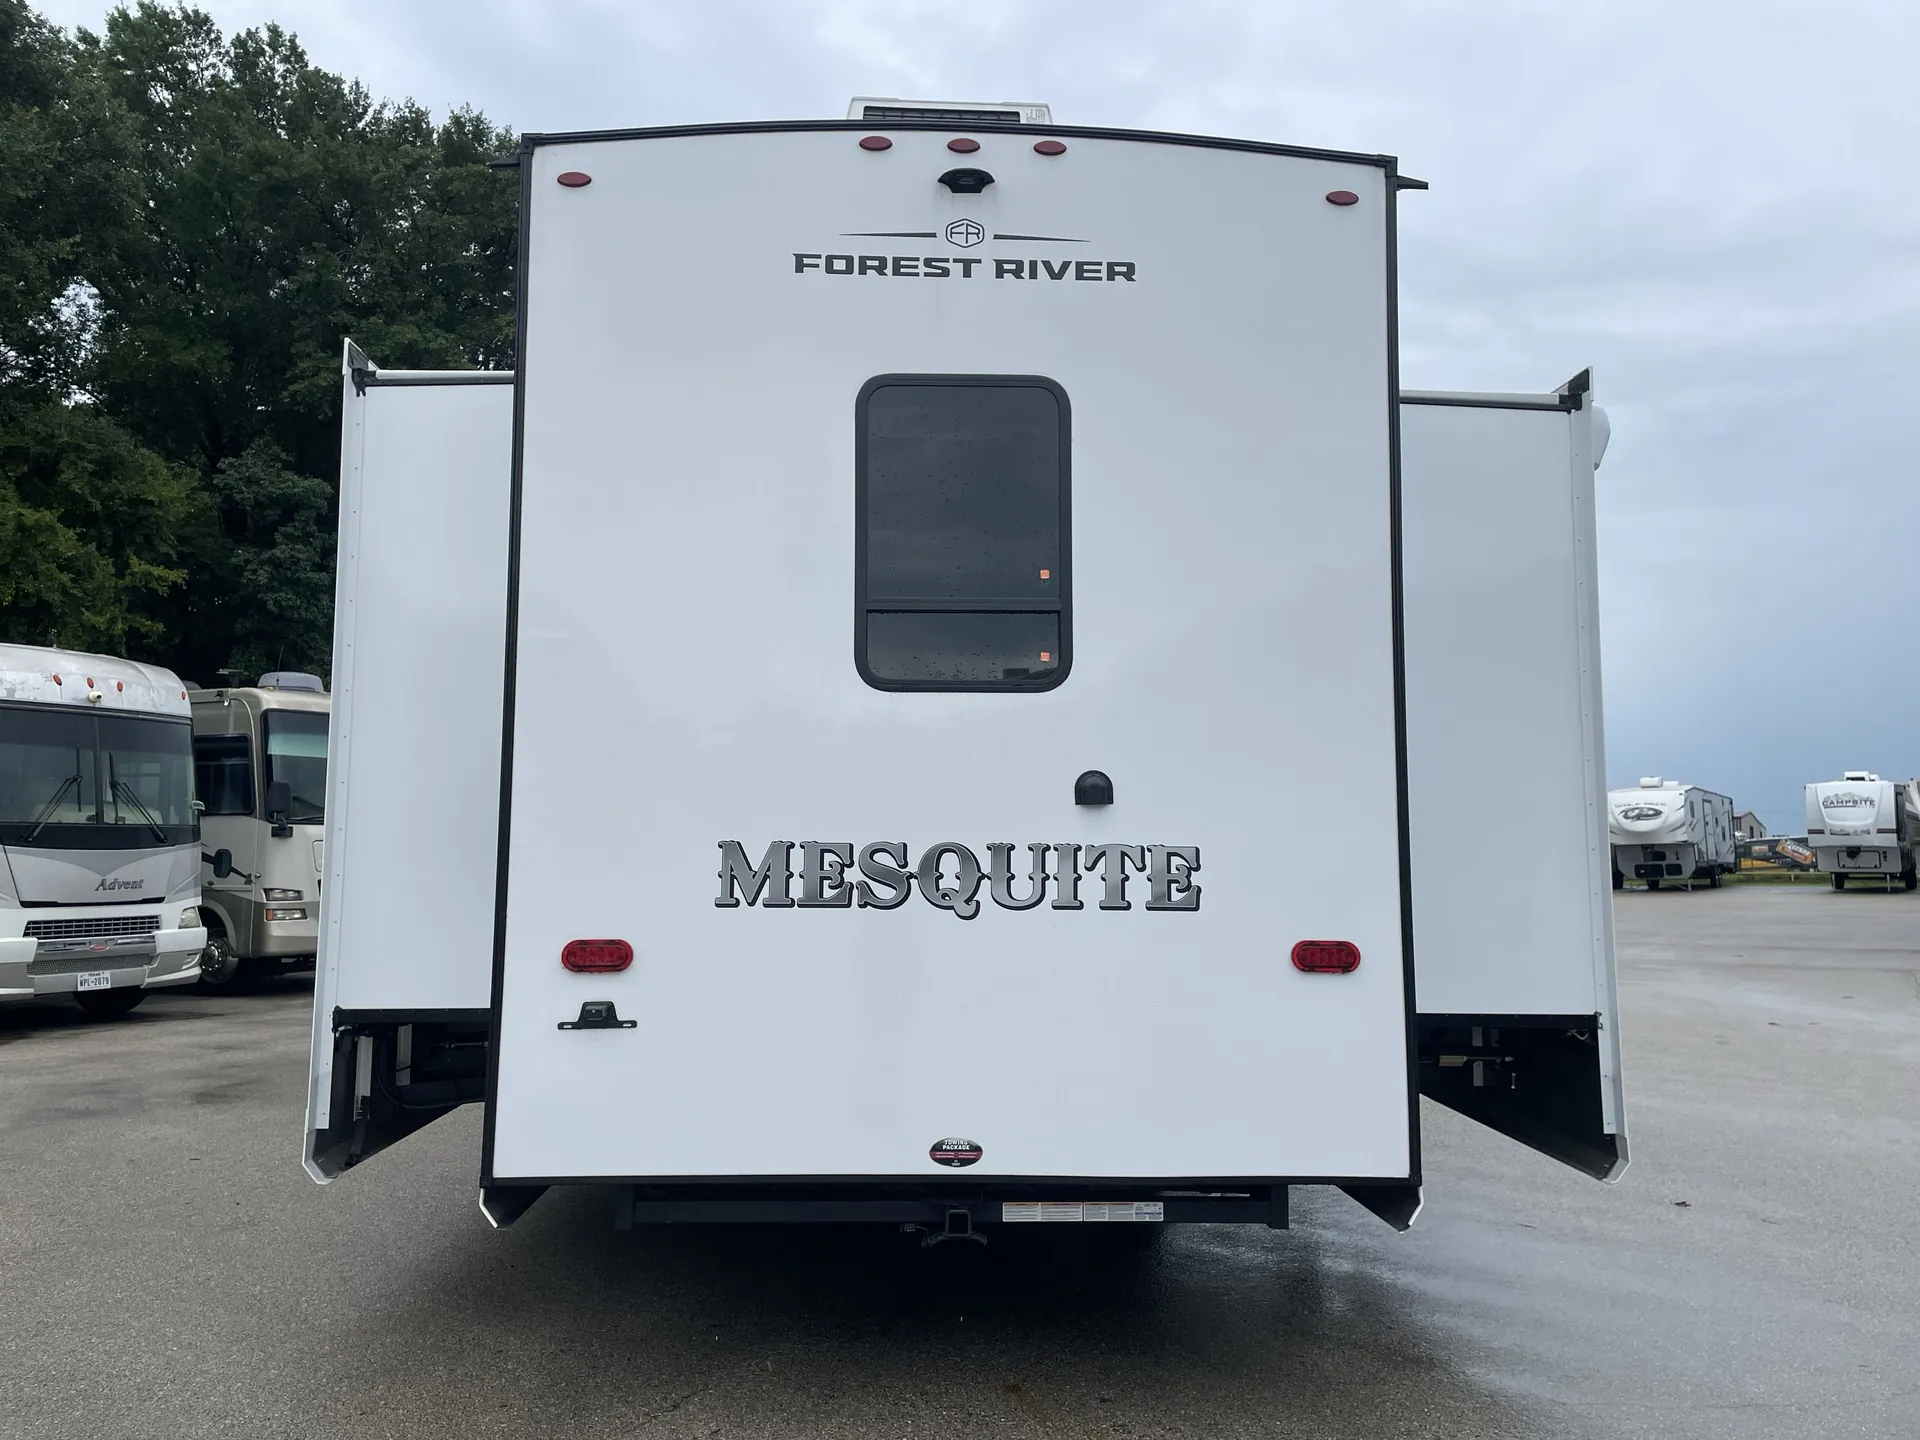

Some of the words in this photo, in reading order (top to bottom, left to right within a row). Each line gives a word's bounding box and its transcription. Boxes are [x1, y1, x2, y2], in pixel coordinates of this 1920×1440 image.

[792, 253, 982, 278] FOREST
[992, 258, 1136, 282] RIVER
[94, 878, 144, 891] Advent
[715, 840, 1202, 920] MESQUITE
